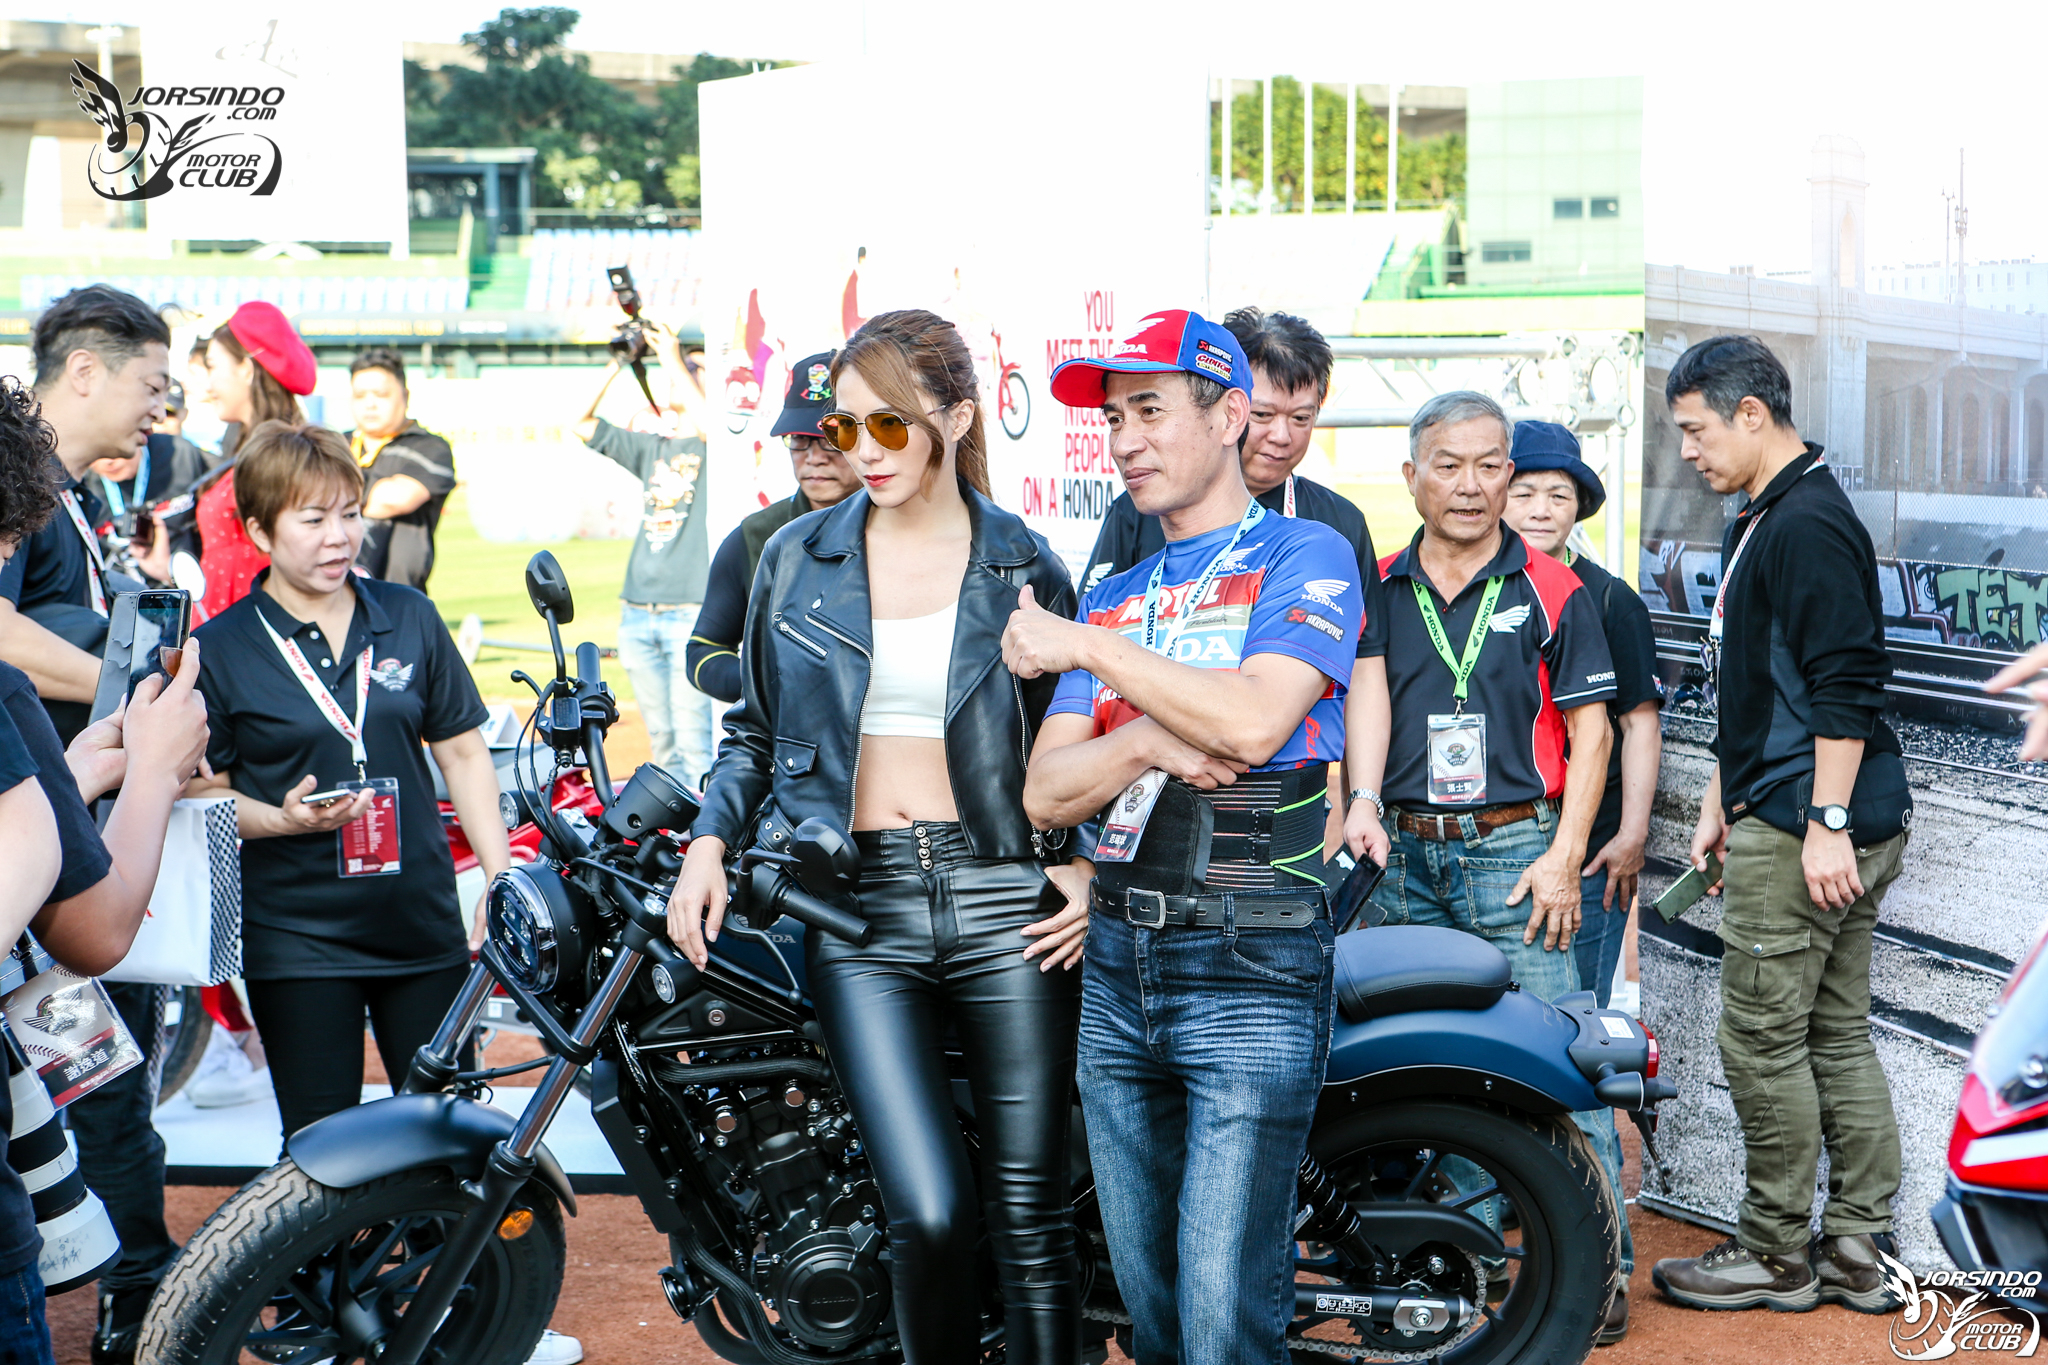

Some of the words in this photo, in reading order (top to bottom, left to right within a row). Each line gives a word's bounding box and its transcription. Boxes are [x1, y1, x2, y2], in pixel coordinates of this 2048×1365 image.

[1083, 290, 1114, 333] YOU
[800, 388, 833, 401] LILY
[1023, 476, 1042, 516] ON
[1048, 477, 1058, 518] A
[1063, 478, 1114, 520] HONDA
[1117, 579, 1222, 623] MOTL
[1190, 558, 1223, 605] HONDA
[1145, 600, 1156, 646] HONDA
[1300, 593, 1345, 617] HONDA
[1477, 595, 1495, 636] HONDA
[1426, 614, 1445, 653] HONDA
[285, 639, 308, 672] HOND
[1460, 660, 1473, 682] NDA
[1585, 670, 1616, 684] HOND
[321, 691, 349, 731] HONDA
